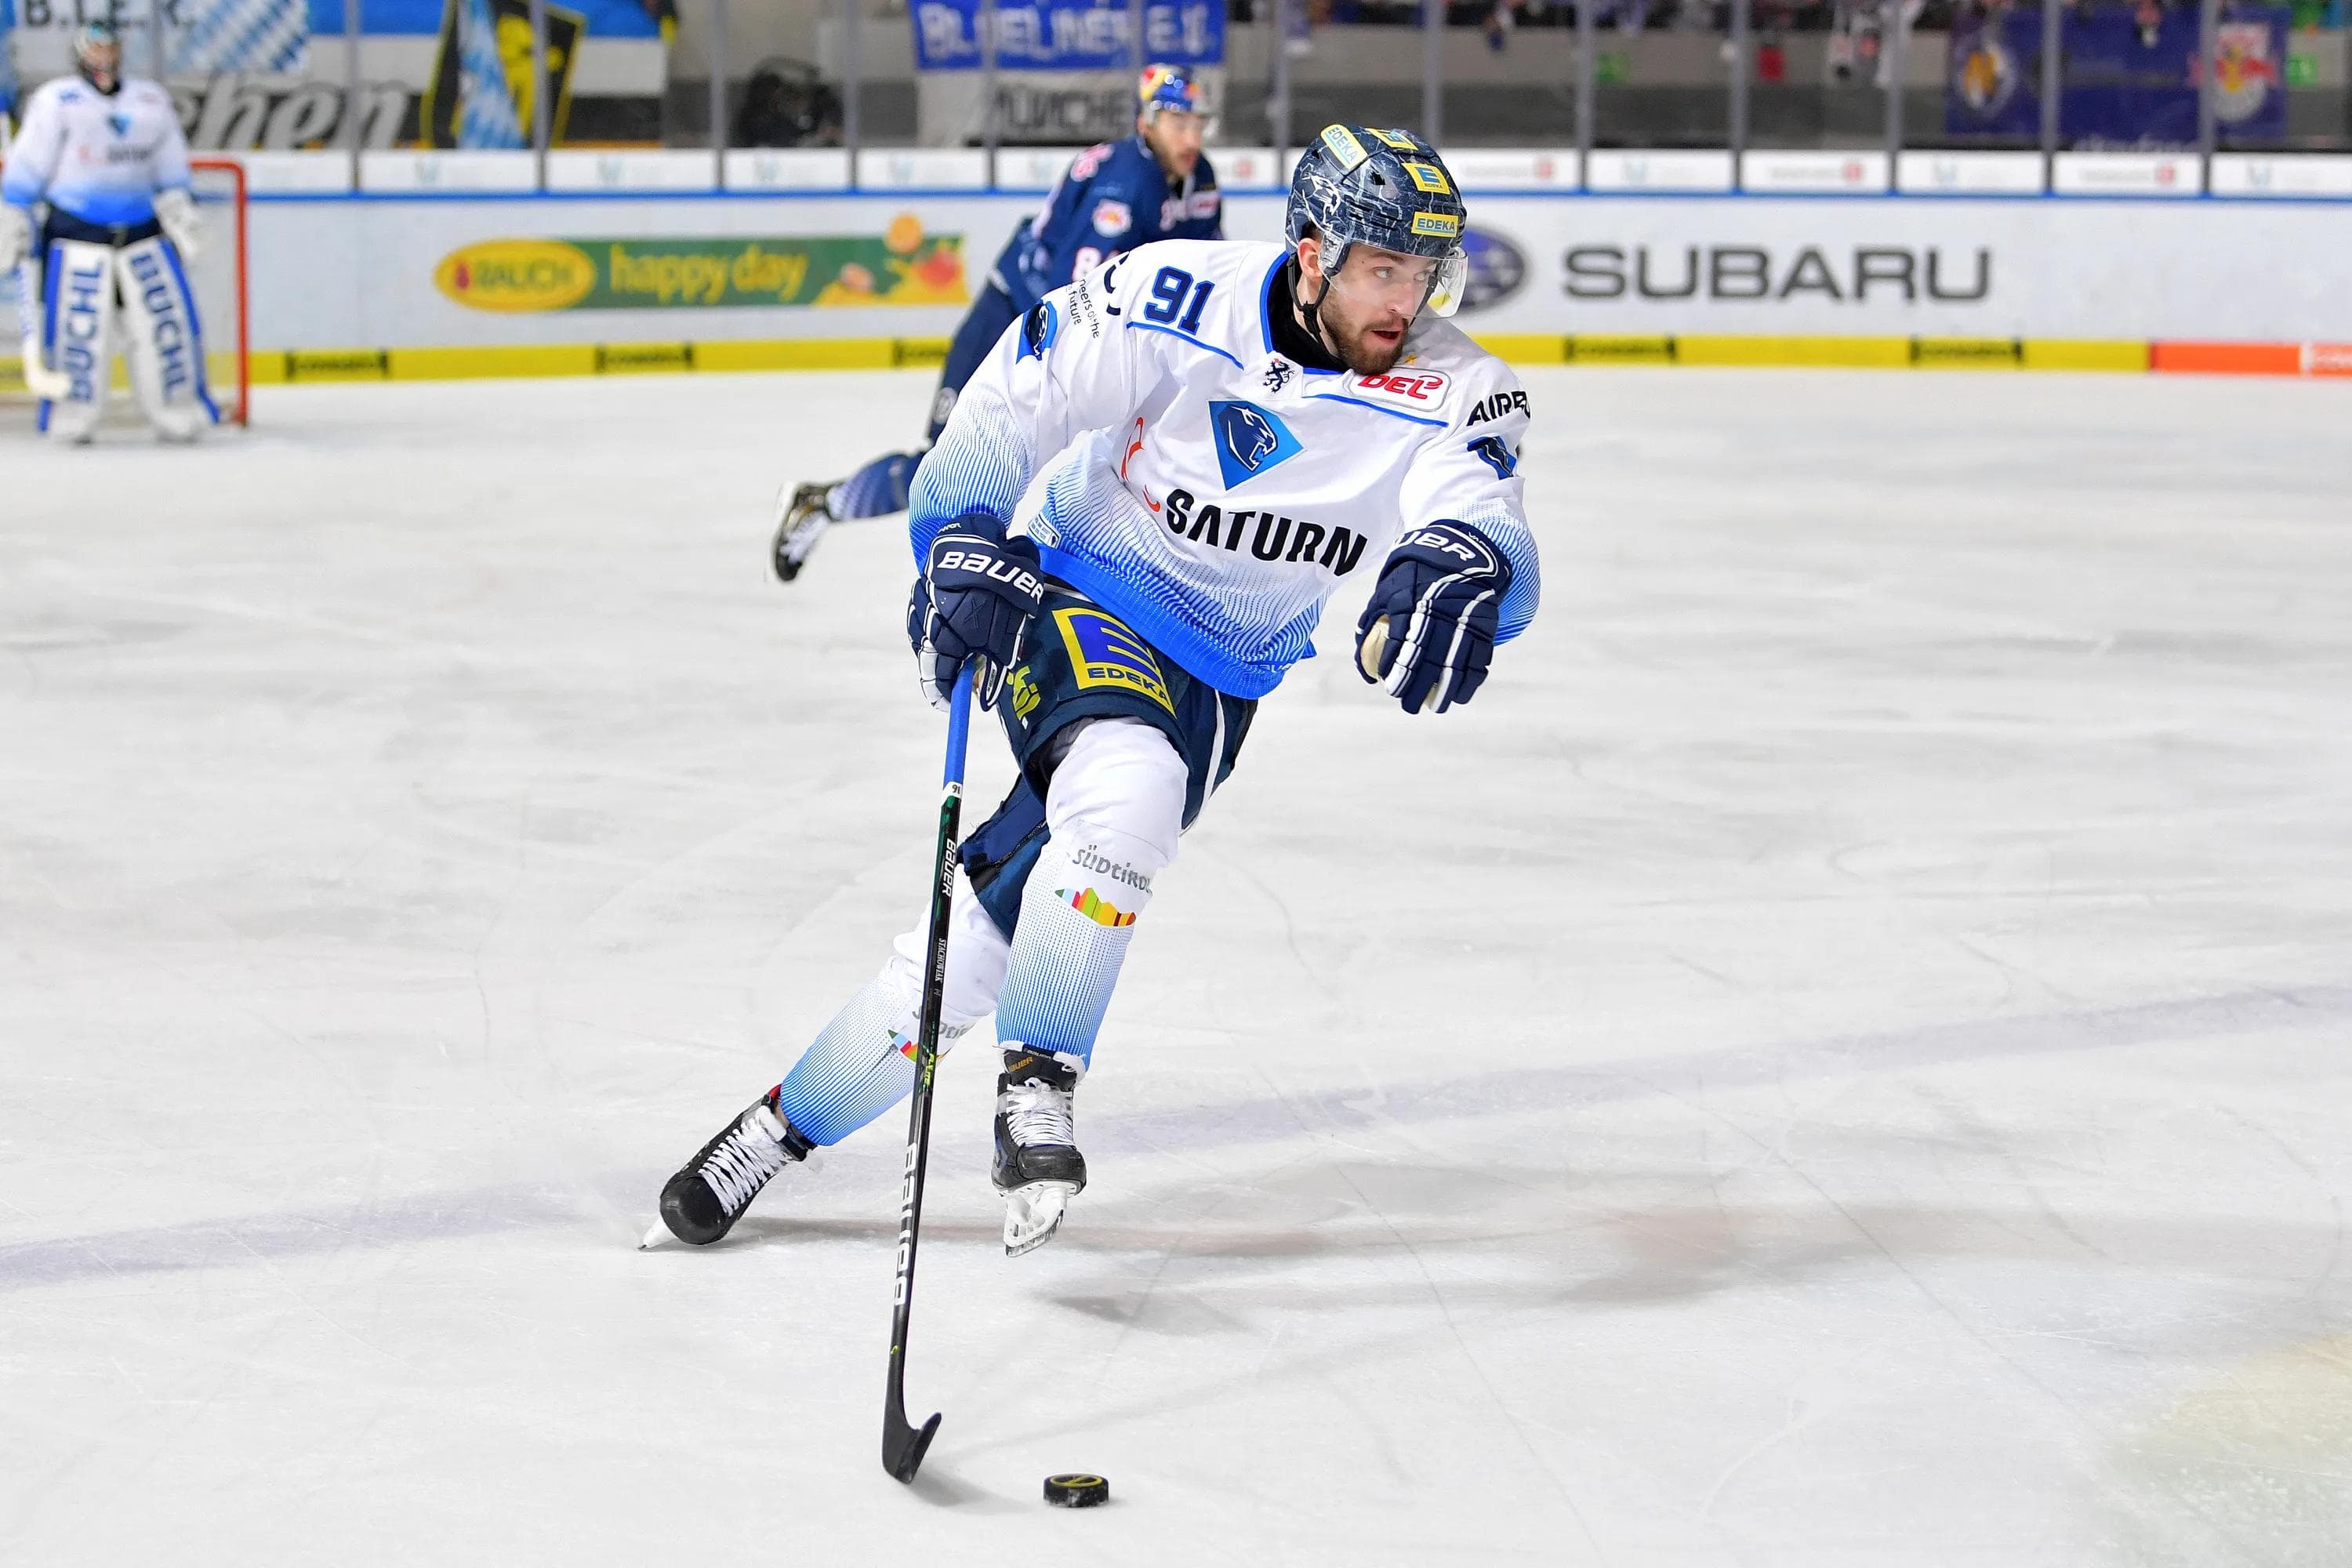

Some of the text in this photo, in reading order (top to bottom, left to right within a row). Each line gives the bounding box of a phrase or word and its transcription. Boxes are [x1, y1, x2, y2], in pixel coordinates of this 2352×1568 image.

[1328, 126, 1359, 162] EDEKA
[1417, 217, 1455, 230] EDEKA
[610, 244, 808, 303] happy day
[1565, 245, 1990, 301] SUBARU
[1069, 290, 1082, 325] future
[1144, 266, 1214, 336] 91
[1357, 374, 1429, 400] DEL
[1167, 488, 1369, 577] SATURN
[937, 551, 1044, 605] BAUER
[1087, 666, 1170, 705] EDEKA
[952, 784, 960, 795] 91
[942, 837, 956, 898] BAUER
[935, 938, 946, 984] STACHOWIAK
